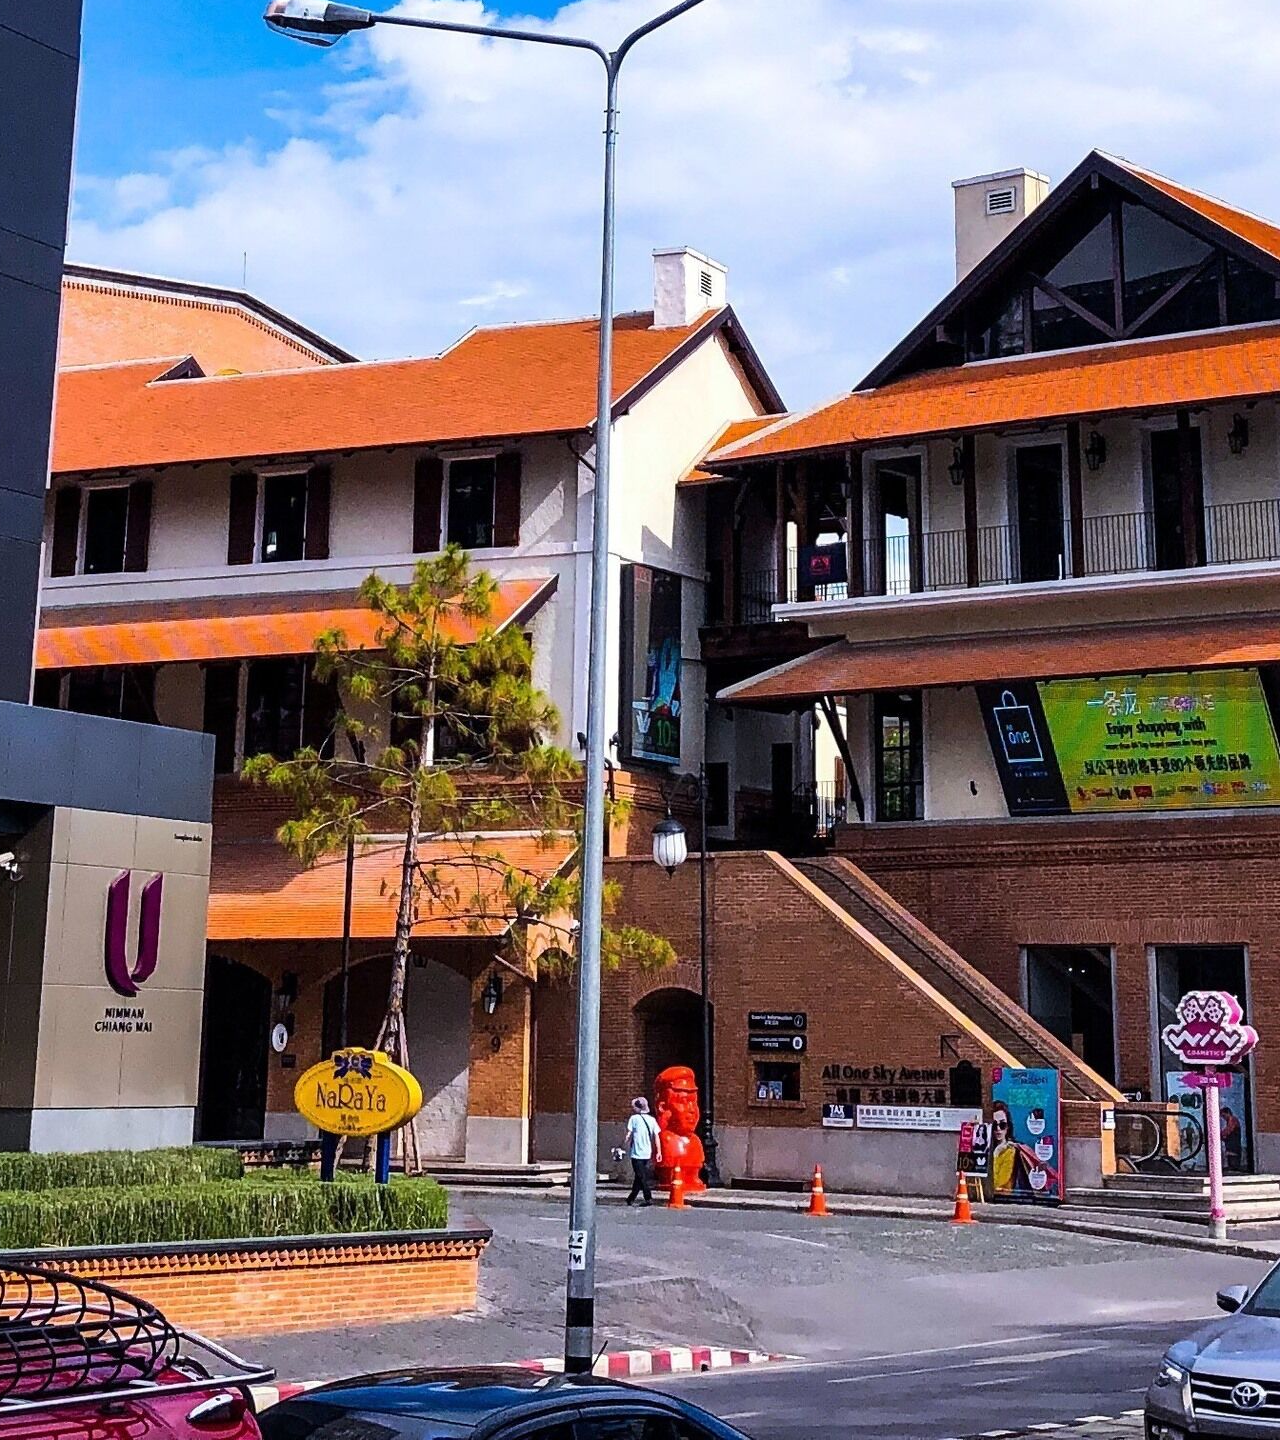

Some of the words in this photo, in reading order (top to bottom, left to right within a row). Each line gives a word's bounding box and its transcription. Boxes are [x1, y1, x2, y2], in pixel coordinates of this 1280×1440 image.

[1105, 720, 1133, 739] Enjoy
[1135, 718, 1182, 737] shopping
[1182, 716, 1206, 731] with
[1008, 730, 1031, 744] one
[104, 1007, 145, 1019] NIMMAN
[94, 1021, 133, 1033] CHIANG
[135, 1021, 153, 1033] MAI
[1186, 1048, 1225, 1057] COSMETICS
[822, 1063, 841, 1080] All
[842, 1065, 870, 1080] One
[872, 1063, 897, 1084] Sky
[899, 1066, 946, 1081] Avenue
[315, 1080, 387, 1113] NaRaYa
[829, 1104, 845, 1115] TAX
